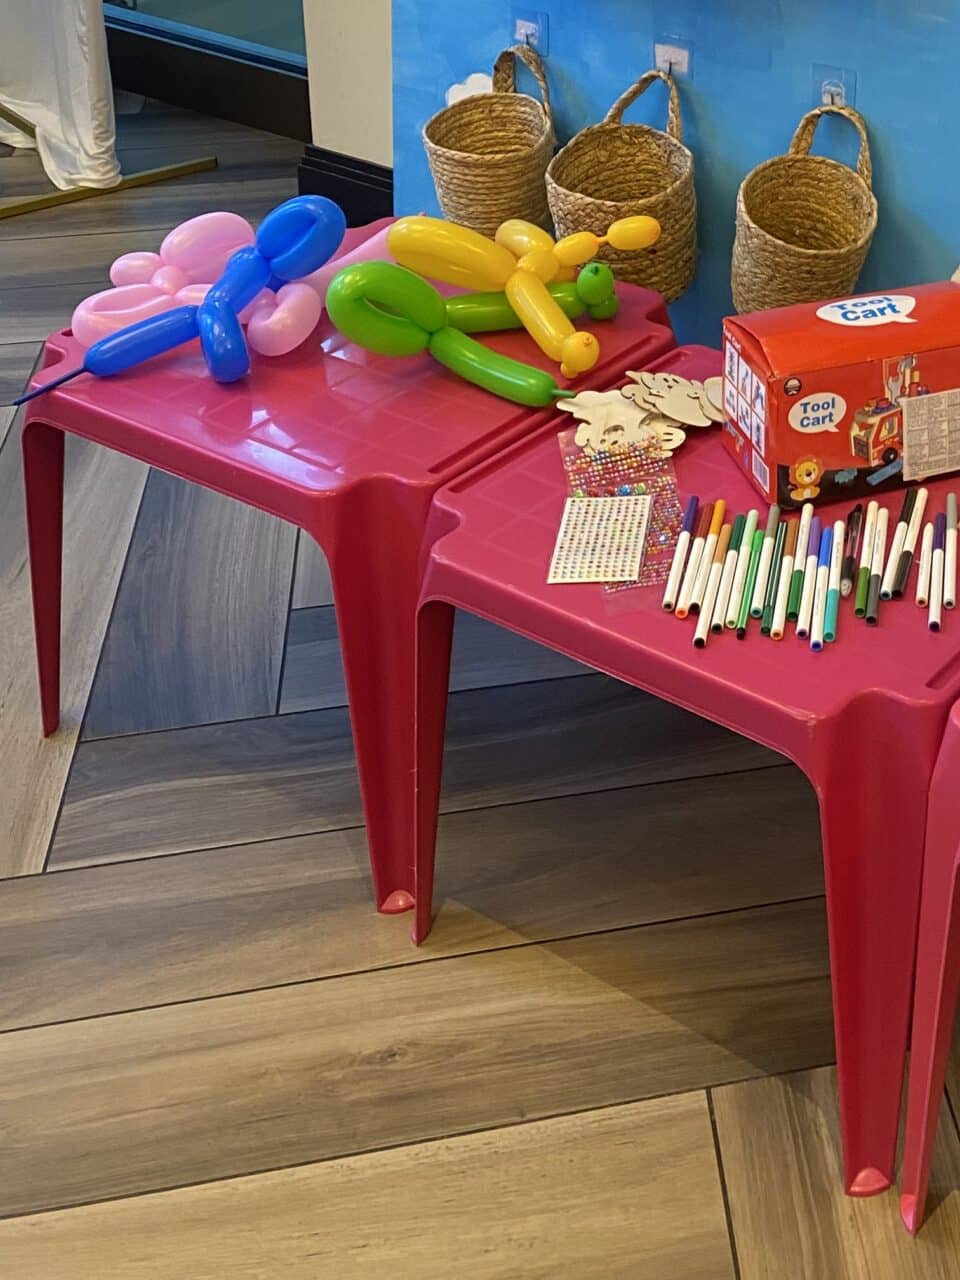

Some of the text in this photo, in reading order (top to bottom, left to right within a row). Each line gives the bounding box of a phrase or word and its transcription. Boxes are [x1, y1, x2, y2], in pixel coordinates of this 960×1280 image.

[830, 296, 893, 310] Tool
[841, 303, 901, 321] Cart
[800, 397, 835, 414] Tool
[800, 412, 834, 428] Cart
